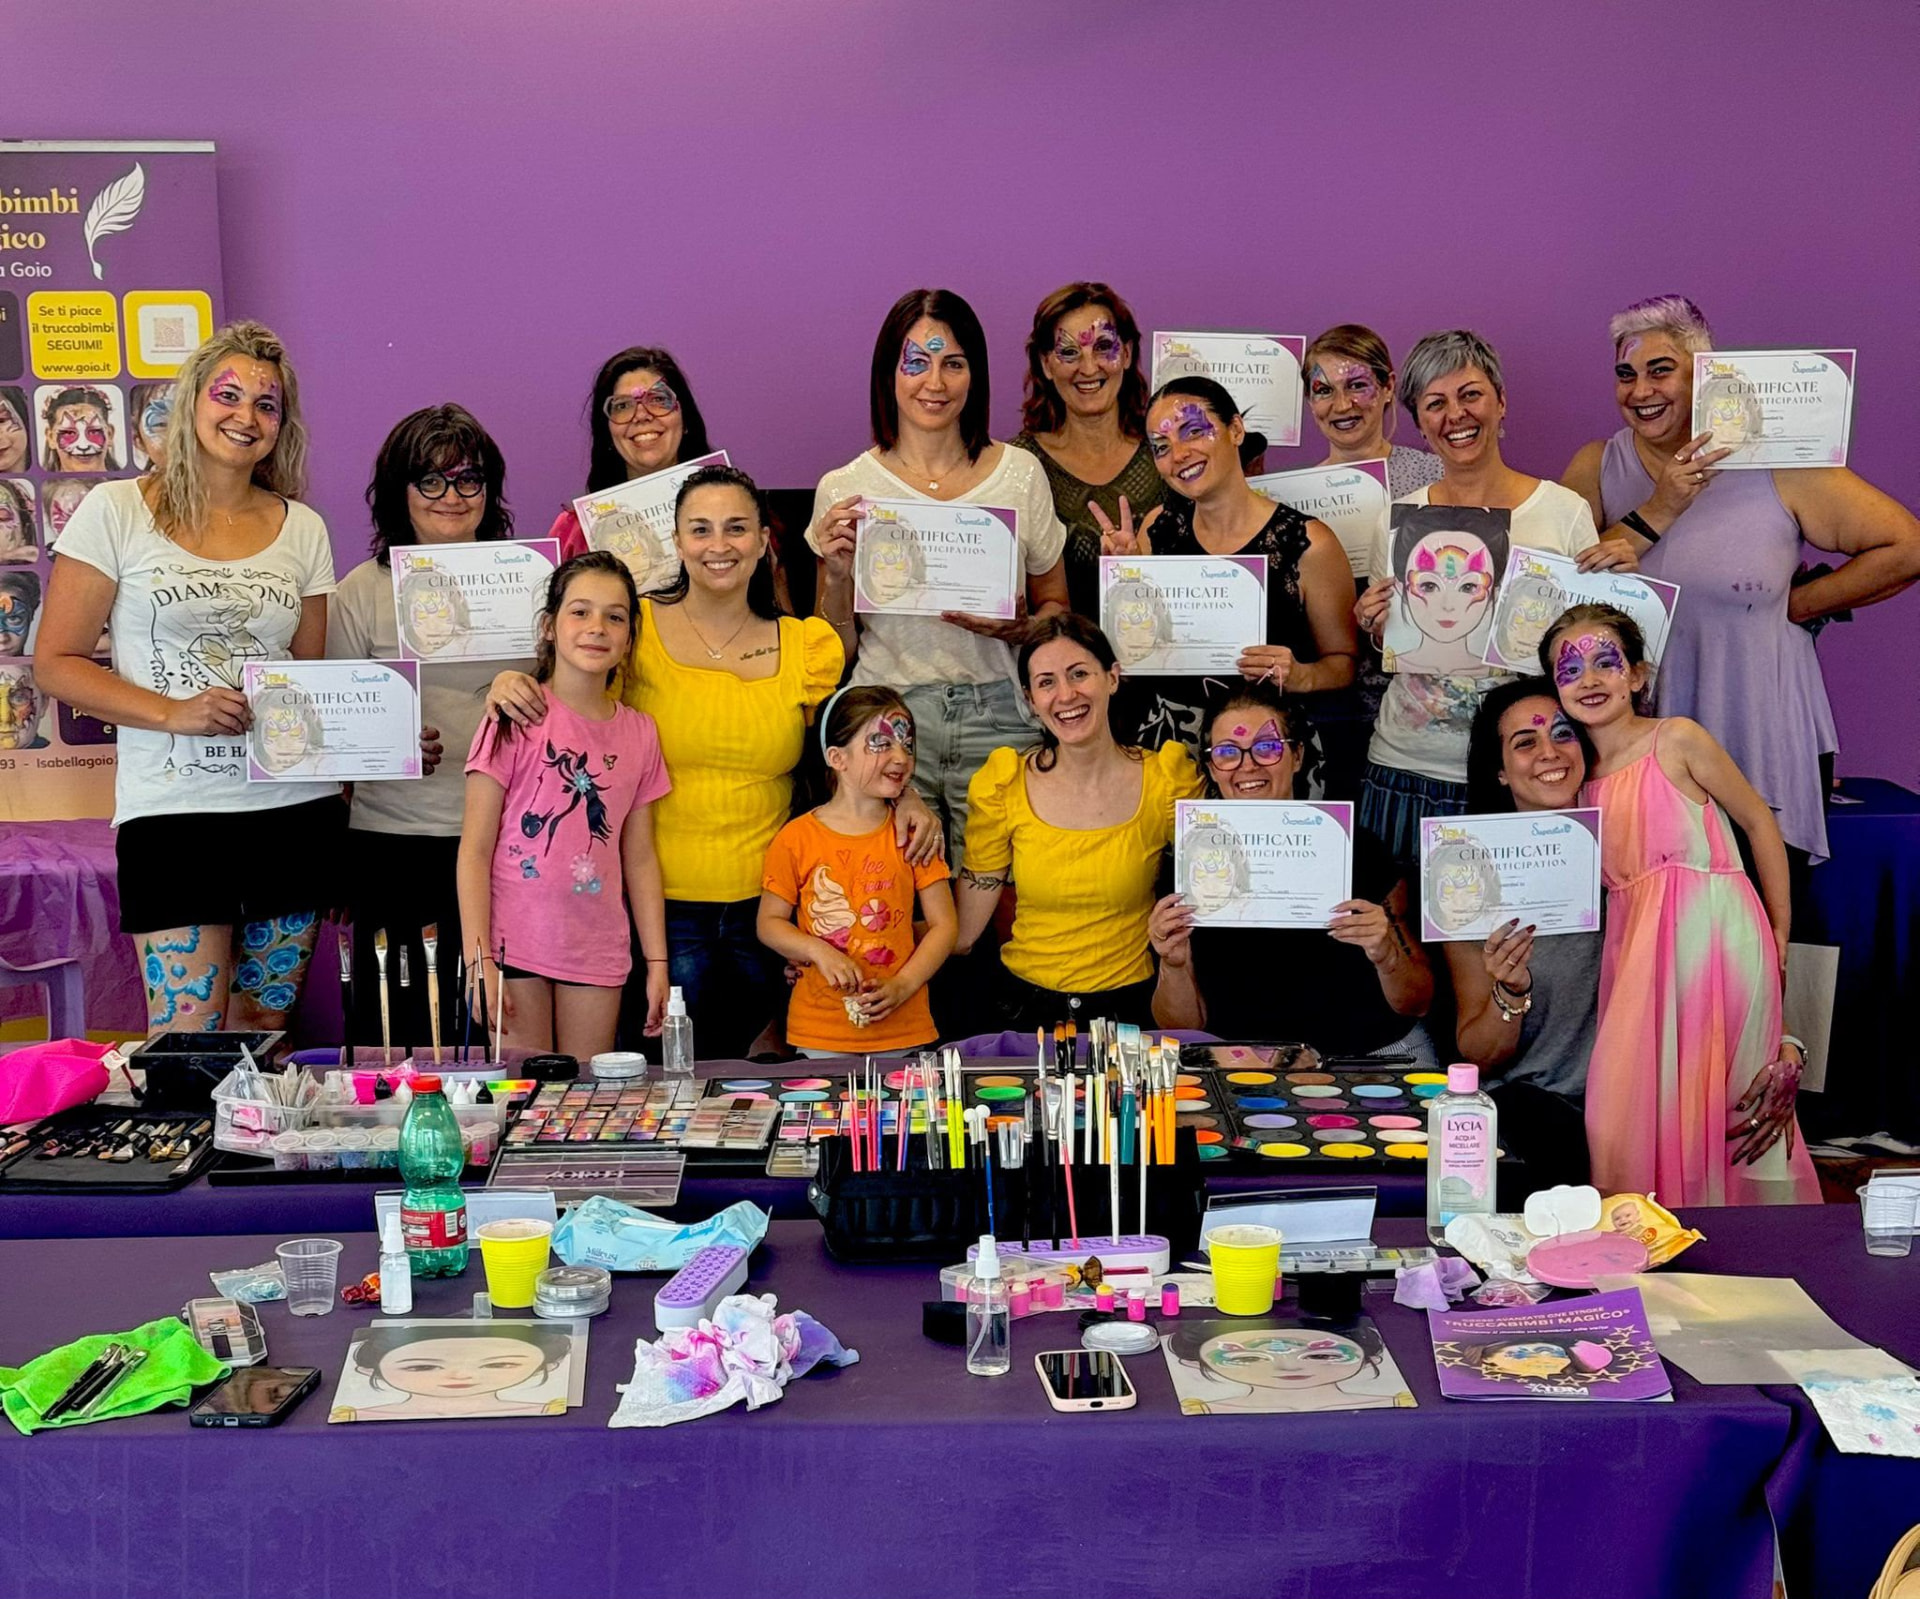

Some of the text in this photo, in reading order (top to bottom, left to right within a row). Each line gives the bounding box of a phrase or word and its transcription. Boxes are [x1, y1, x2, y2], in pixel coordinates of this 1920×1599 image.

[0, 223, 46, 250] ico
[10, 262, 52, 278] Goio
[38, 305, 102, 318] Se ti piace
[32, 322, 115, 334] il truccabimbi
[47, 340, 102, 350] SEGUIMI!
[42, 362, 111, 375] www.goio.it
[1184, 362, 1270, 376] CERTIFICATE
[1727, 380, 1818, 395] CERTIFICATE
[616, 500, 676, 528] CERTIFIC
[890, 529, 982, 545] CERTIFICATE
[428, 572, 524, 588] CERTIFICATE
[1134, 586, 1229, 600] CERTIFICATE
[282, 691, 382, 705] CERTIFICATE
[204, 746, 226, 758] BE
[36, 755, 117, 769] Isabellagoio
[1210, 833, 1312, 847] CERTIFICATE
[1459, 843, 1562, 860] CERTIFICATE
[1448, 1120, 1482, 1131] LYCIA
[1443, 1320, 1554, 1328] TRUCCABIMBI
